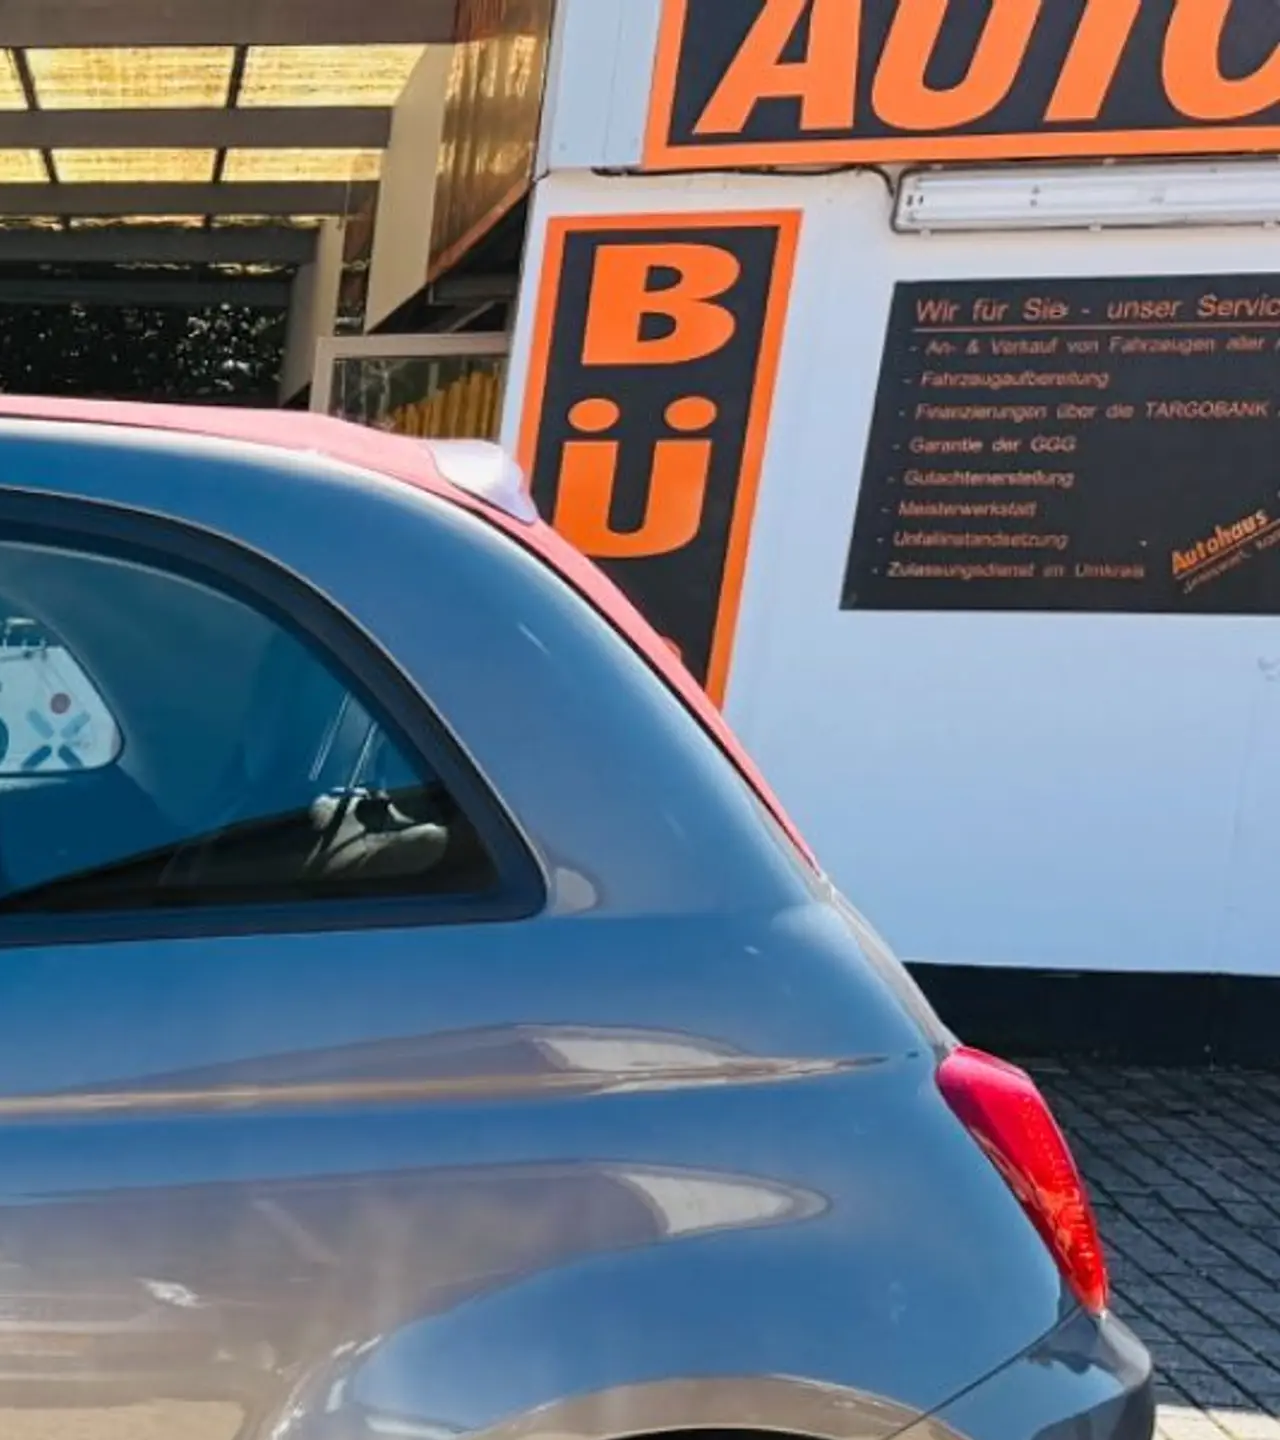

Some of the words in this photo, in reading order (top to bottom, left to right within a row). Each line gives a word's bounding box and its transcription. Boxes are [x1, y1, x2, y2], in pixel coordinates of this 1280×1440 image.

[915, 298, 962, 323] Wir
[972, 297, 1011, 322] für
[1021, 296, 1070, 322] Sie
[1106, 299, 1184, 320] unser
[1066, 339, 1099, 354] von
[1105, 401, 1136, 420] die
[1145, 399, 1271, 421] TARGOBANK
[908, 435, 984, 454] Garantie
[991, 435, 1022, 453] der
[1171, 507, 1269, 576] Autohaus
